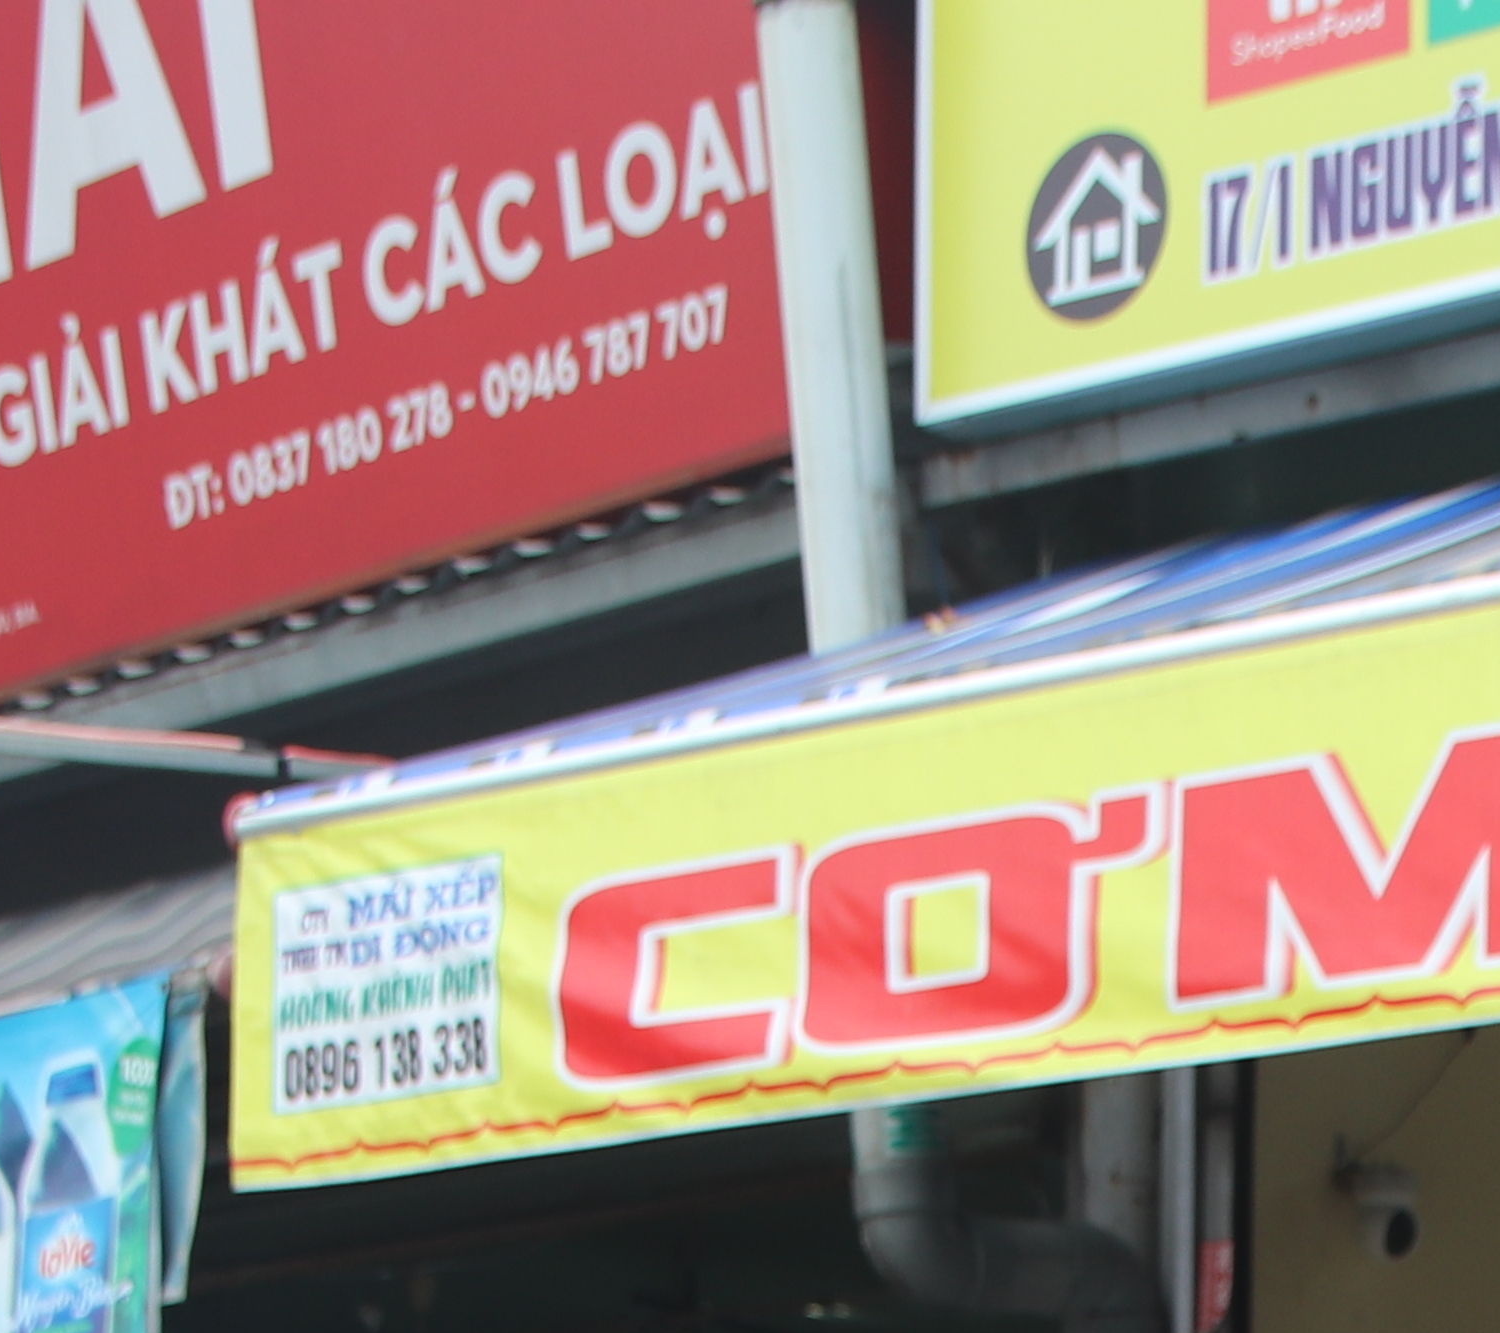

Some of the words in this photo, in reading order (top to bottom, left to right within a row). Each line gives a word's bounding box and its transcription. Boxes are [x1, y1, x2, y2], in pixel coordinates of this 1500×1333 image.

[1230, 2, 1387, 68] ShopeeFood
[138, 234, 345, 415] KHÁT
[361, 164, 544, 328] CÁC
[555, 80, 774, 262] LOẠI
[1208, 156, 1292, 280] 17/1
[163, 462, 225, 529] ĐT:
[227, 430, 311, 508] 0837
[316, 408, 384, 480] 180
[387, 386, 454, 458] 278
[456, 397, 477, 419] -
[481, 343, 580, 421] 0946
[583, 319, 652, 391] 787
[657, 281, 730, 363] 707
[285, 1039, 361, 1100] 0896
[374, 1027, 422, 1089] 138
[432, 1015, 487, 1078] 338
